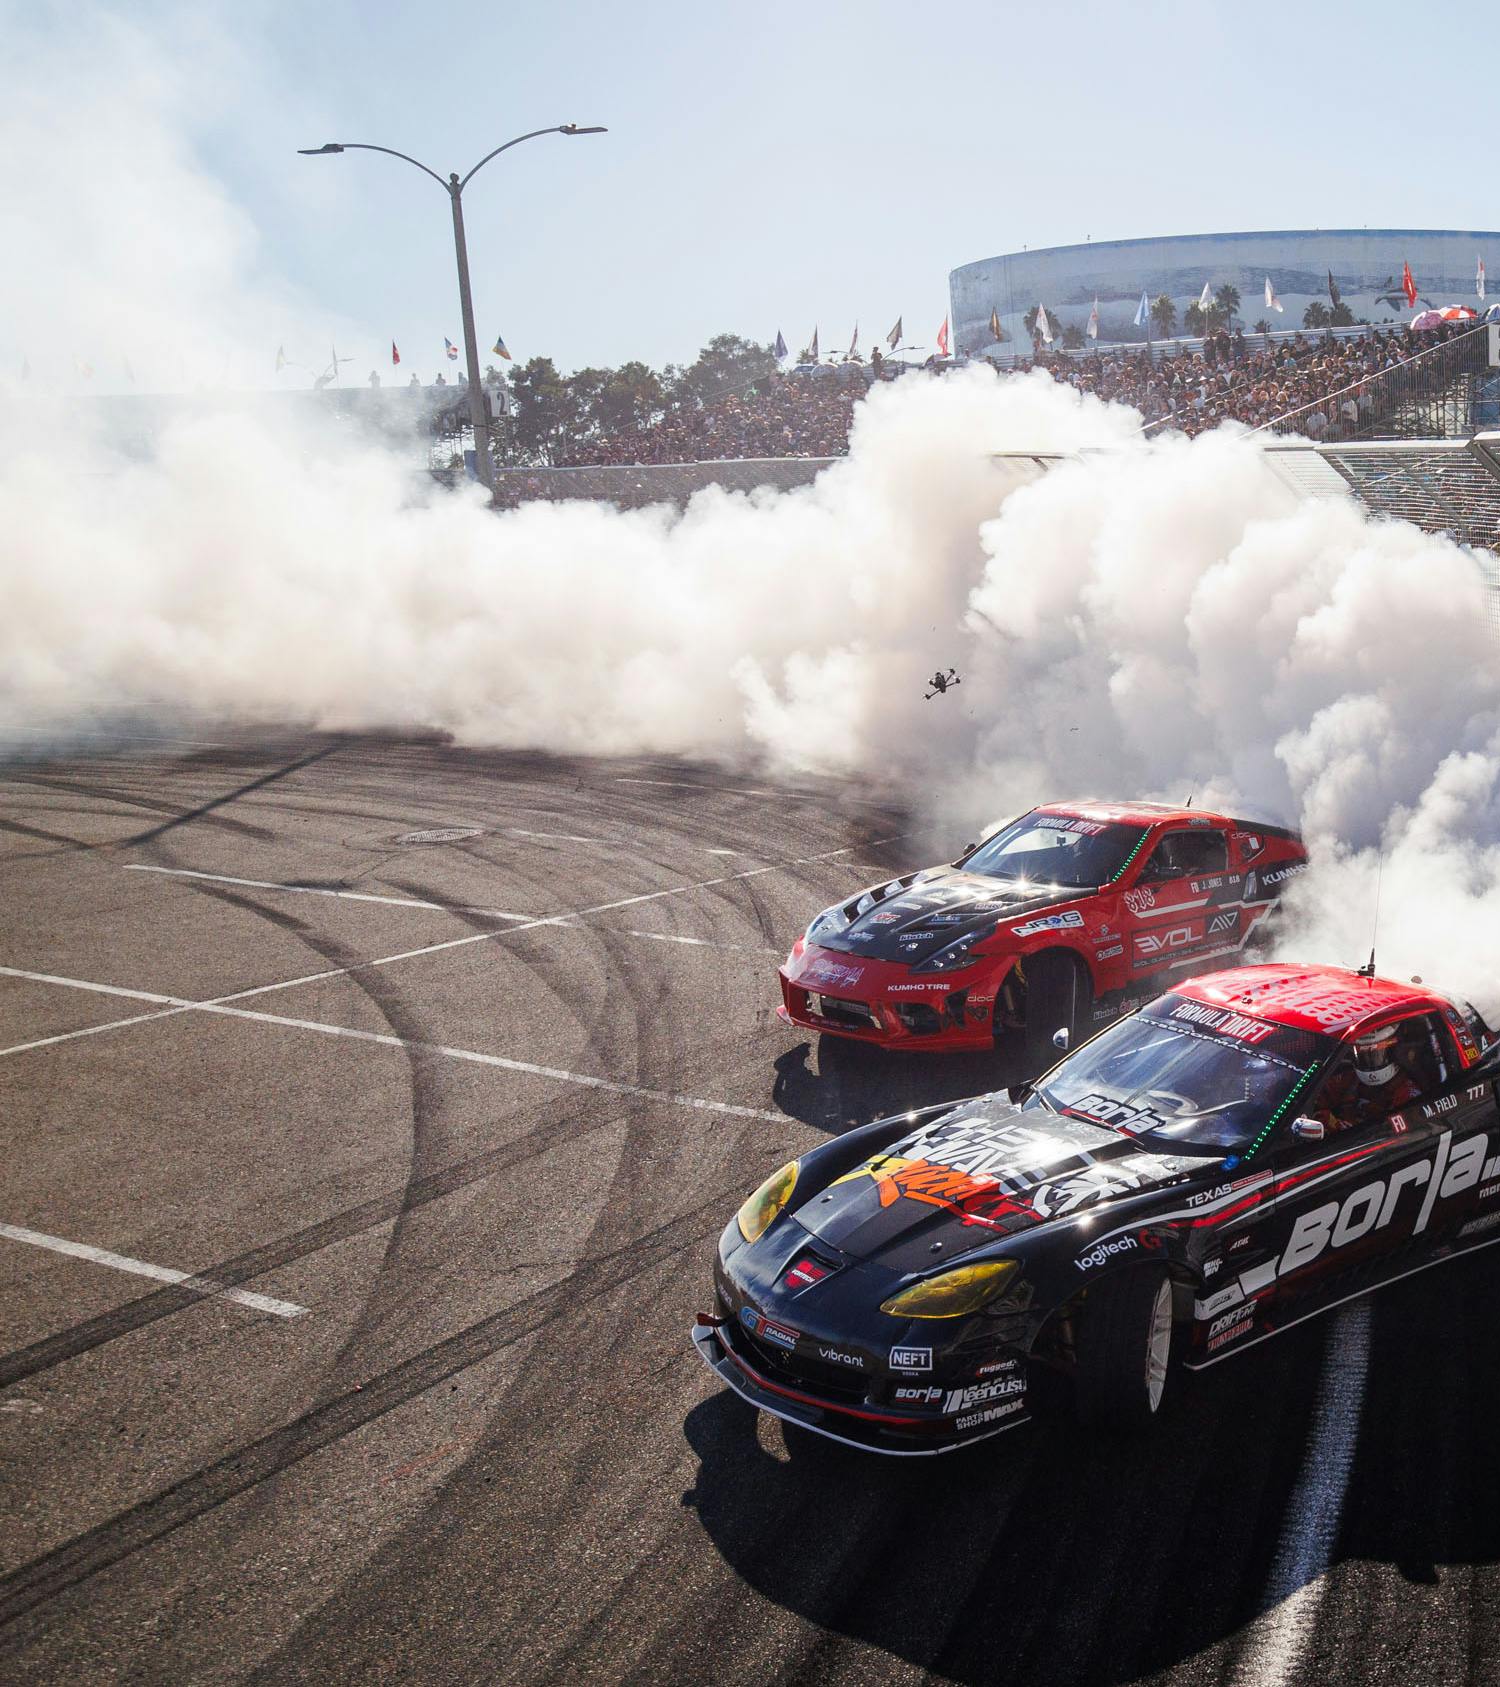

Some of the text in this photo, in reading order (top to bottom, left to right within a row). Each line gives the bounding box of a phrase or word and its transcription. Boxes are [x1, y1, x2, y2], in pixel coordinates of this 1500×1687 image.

[497, 391, 508, 416] 2
[1034, 817, 1107, 836] FORMULA DRIFT
[1262, 863, 1311, 886] KUMHO
[887, 983, 950, 992] KUMHO TIRE
[1169, 1003, 1230, 1028] FORMULA
[1218, 1016, 1274, 1042] DRIFT
[1391, 1084, 1485, 1133] FD M. FIELD 777
[1185, 1183, 1232, 1208] TEXAS
[1073, 1235, 1139, 1271] logitech
[765, 1327, 797, 1345] RADIAL
[819, 1347, 864, 1367] vibrant
[893, 1352, 927, 1366] NEFT
[955, 1412, 984, 1424] PARTS
[983, 1398, 1025, 1422] MAX
[957, 1417, 984, 1431] SHOP
